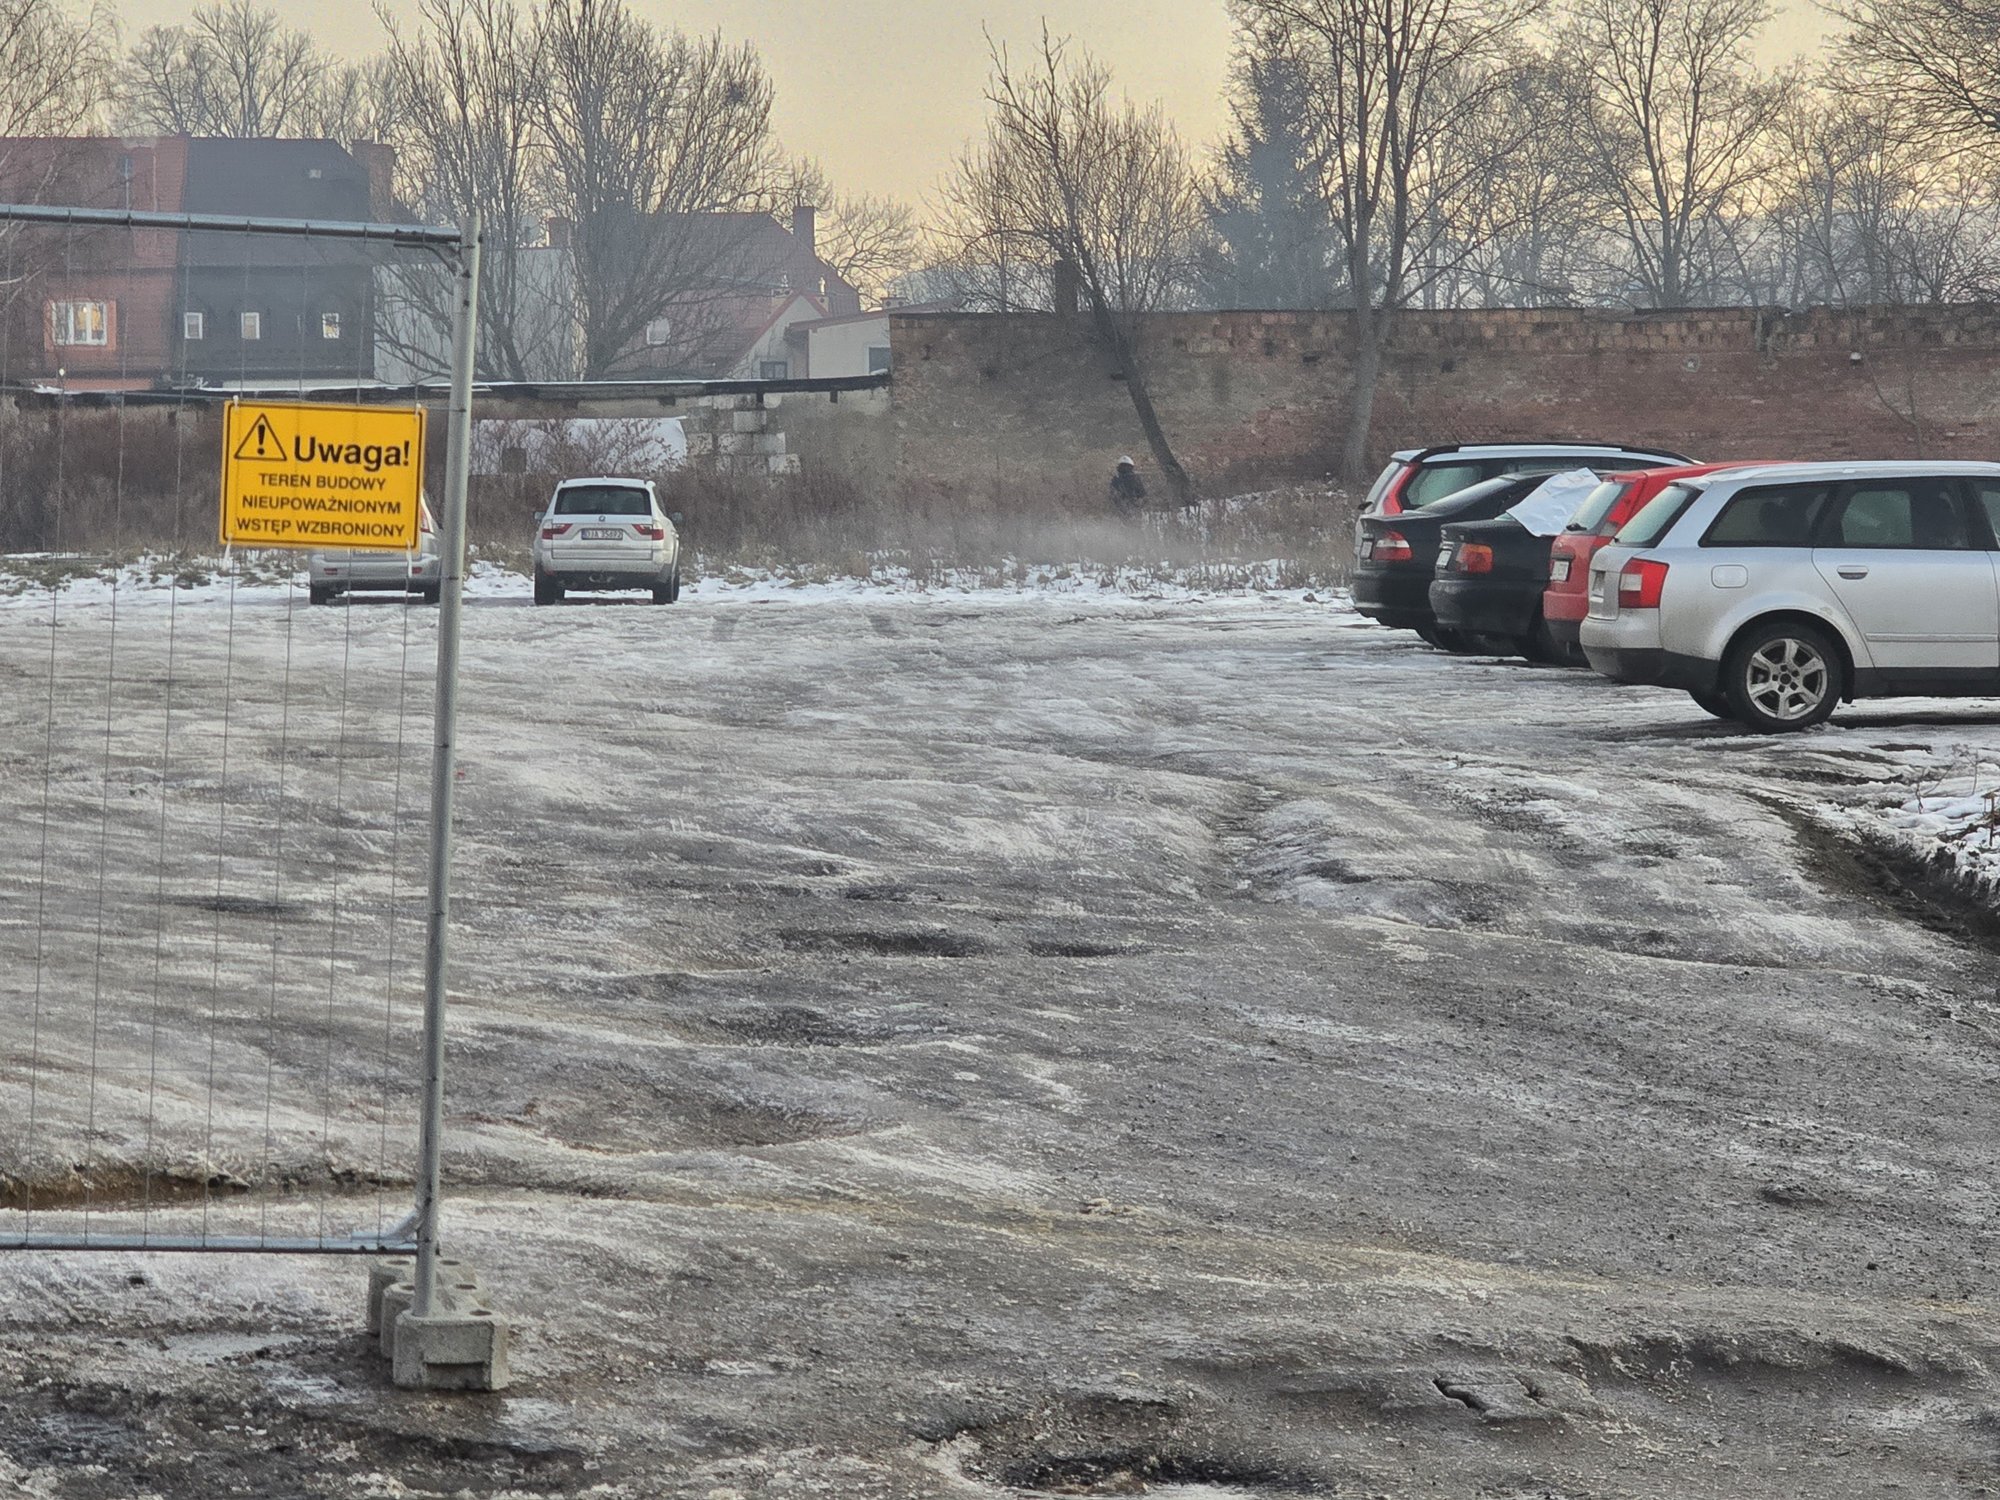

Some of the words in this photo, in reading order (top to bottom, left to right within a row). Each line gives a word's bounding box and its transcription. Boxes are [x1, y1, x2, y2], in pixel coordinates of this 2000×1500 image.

[294, 435, 410, 472] Uwaga!
[259, 473, 311, 488] TEREN
[316, 475, 386, 490] BUDOWY
[242, 495, 400, 514] NIEUPOWAŻNIONYM
[236, 517, 291, 535] WSTĘP
[297, 521, 405, 537] WZBRONIONY
